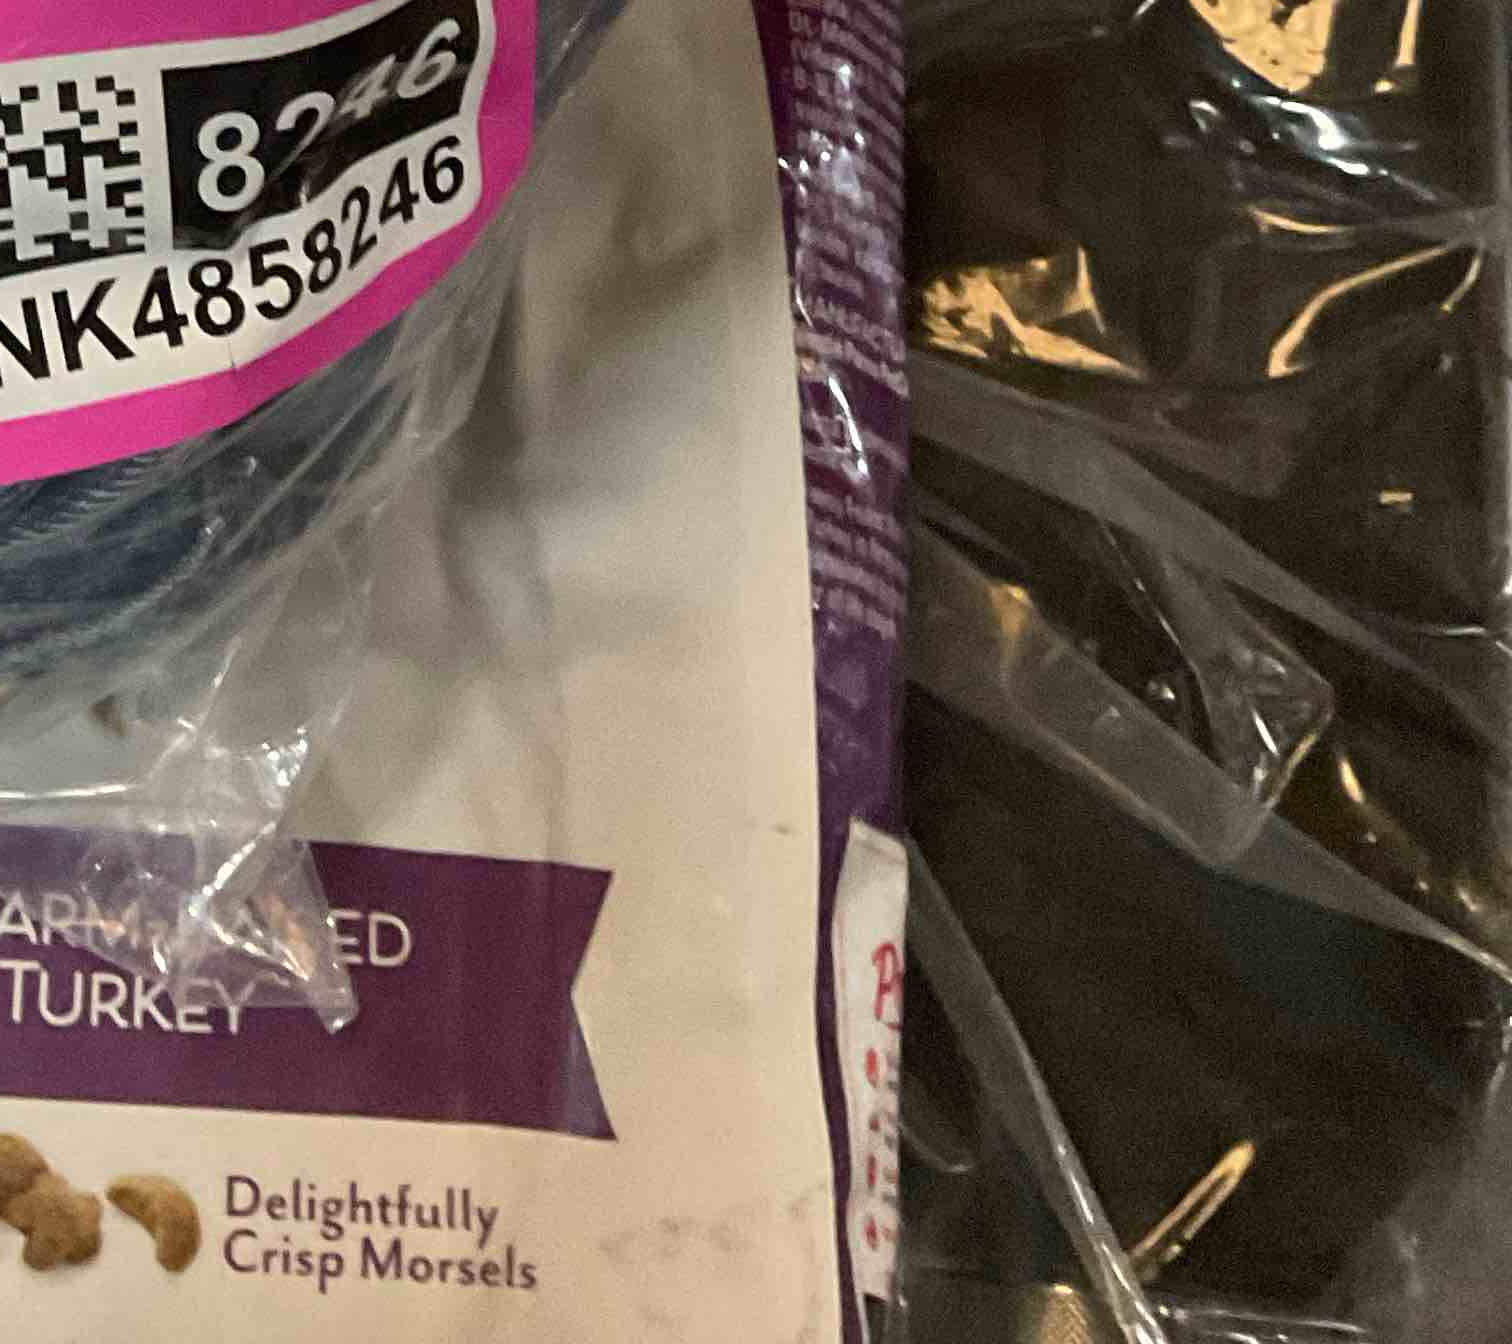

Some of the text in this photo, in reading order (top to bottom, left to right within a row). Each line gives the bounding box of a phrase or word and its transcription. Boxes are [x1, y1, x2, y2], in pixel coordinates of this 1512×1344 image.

[197, 18, 461, 214] 8246
[224, 1175, 501, 1242] Delightfully
[222, 1229, 540, 1295] Crisp Morsels
